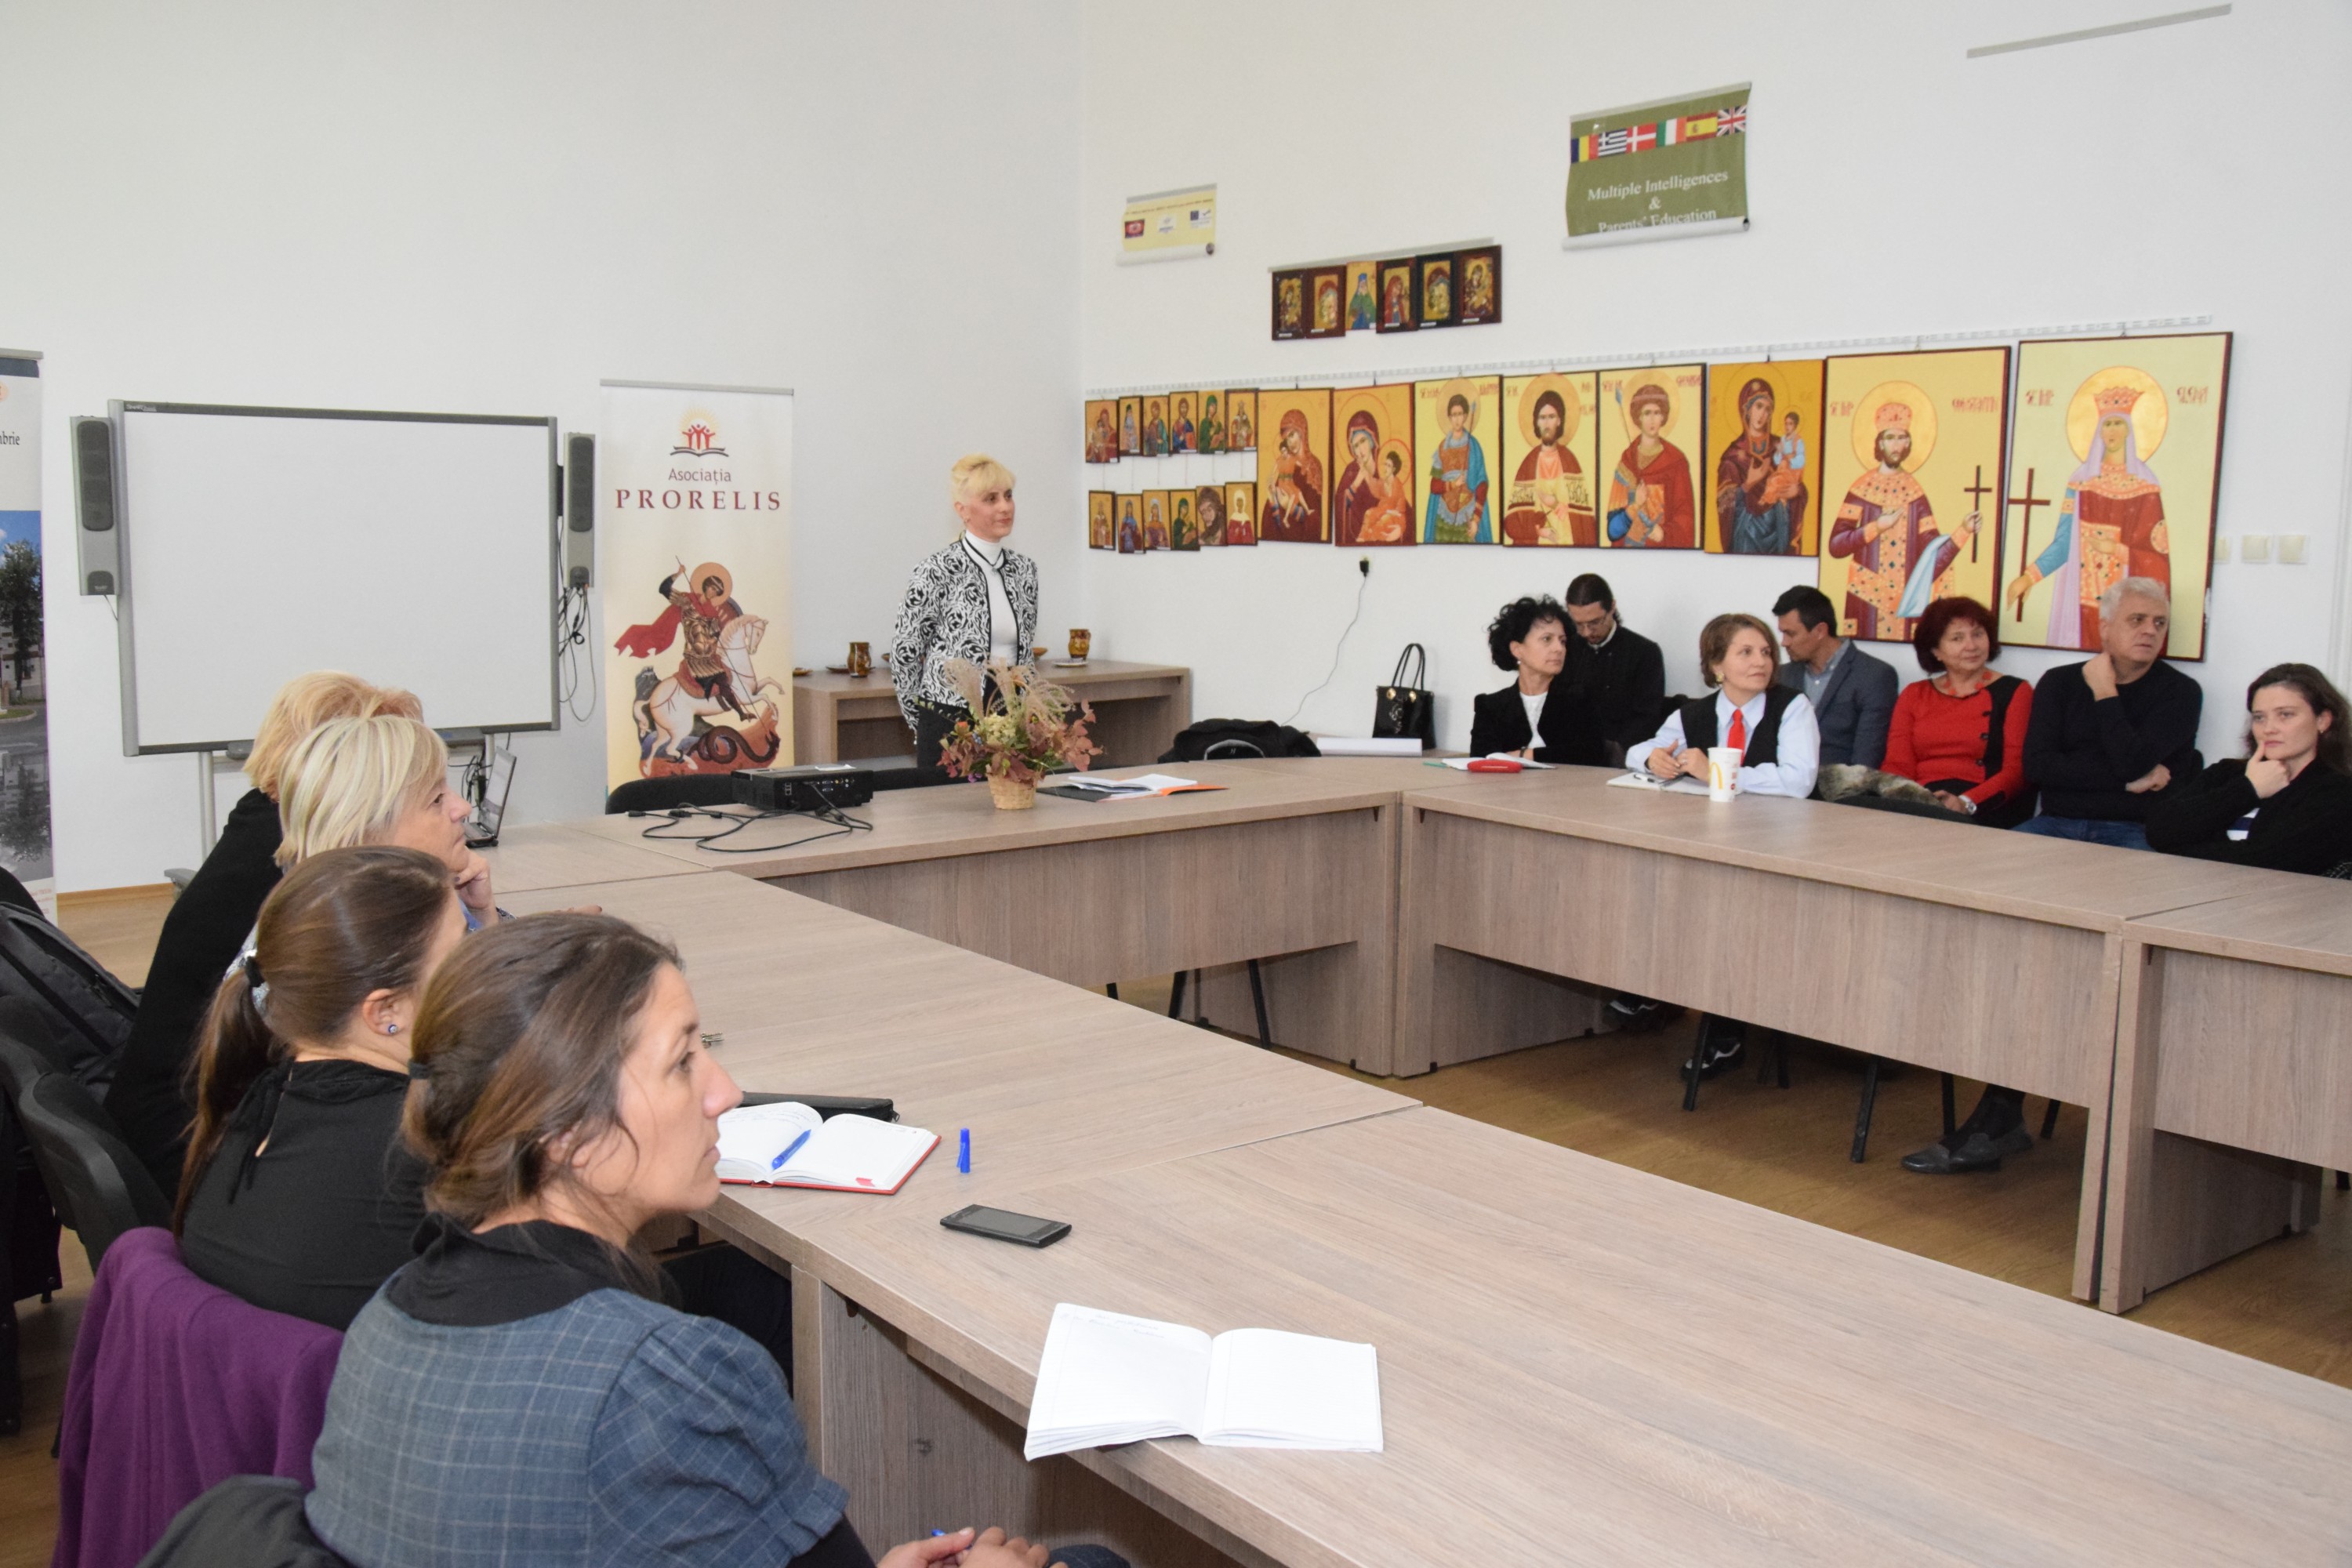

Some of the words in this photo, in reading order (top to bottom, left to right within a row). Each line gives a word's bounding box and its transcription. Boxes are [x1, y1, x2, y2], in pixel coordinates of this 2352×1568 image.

[1588, 183, 1642, 201] Multiple
[1646, 171, 1729, 191] Intelligences
[1649, 196, 1661, 210] &
[1650, 209, 1717, 227] Education
[668, 468, 731, 485] Asociația
[615, 488, 781, 511] PRORELIS
